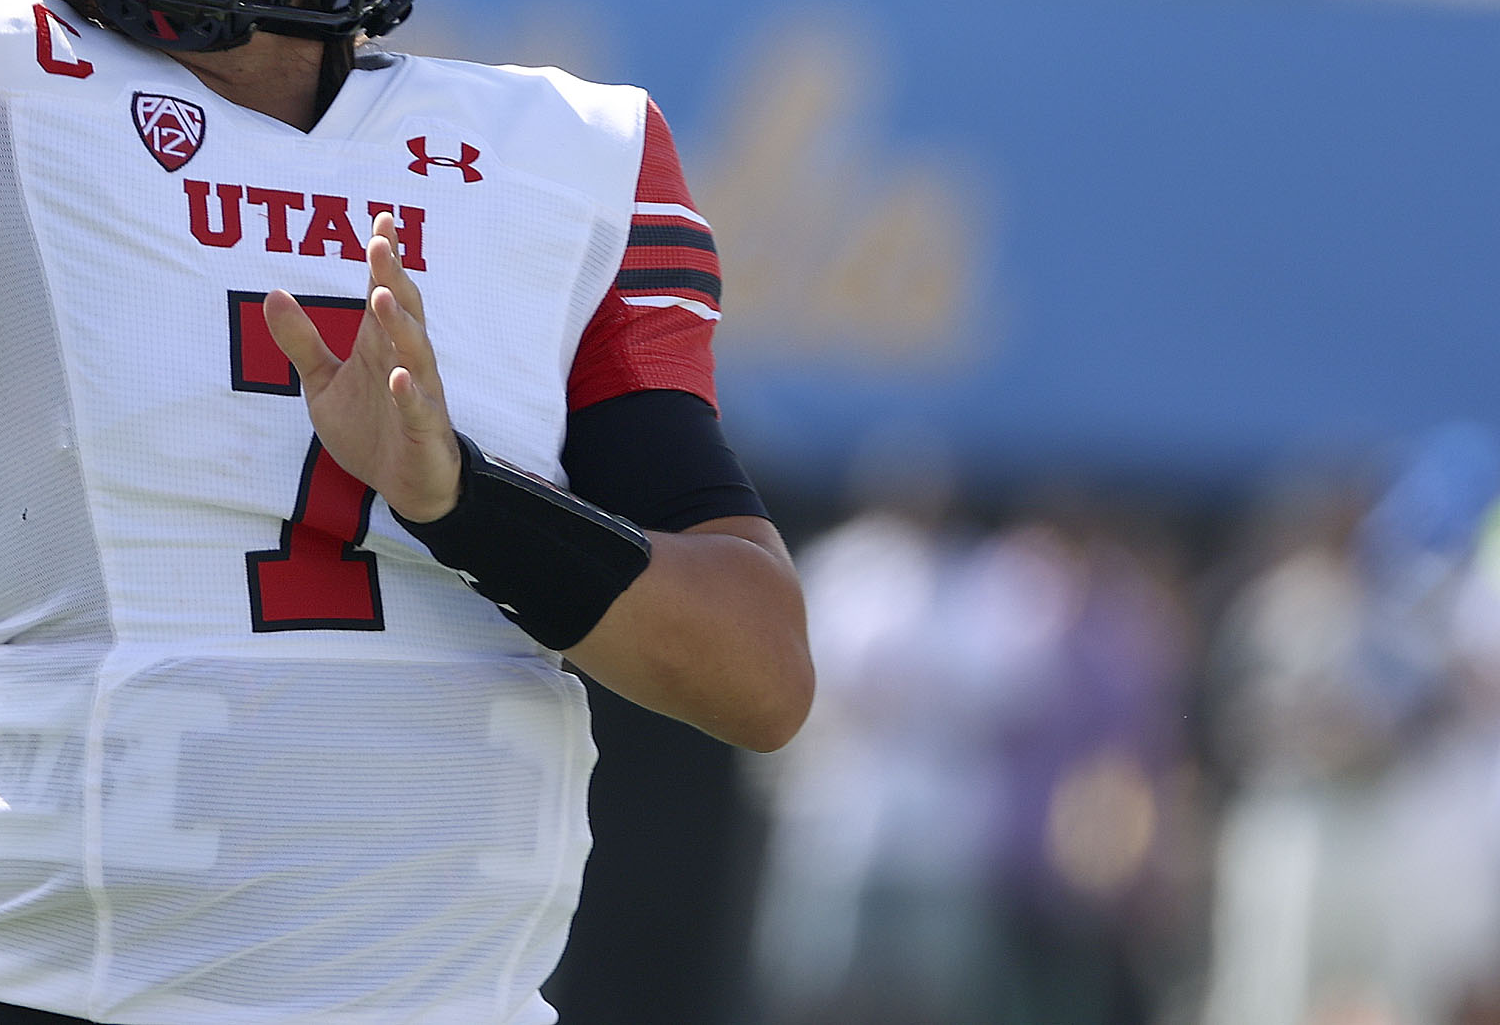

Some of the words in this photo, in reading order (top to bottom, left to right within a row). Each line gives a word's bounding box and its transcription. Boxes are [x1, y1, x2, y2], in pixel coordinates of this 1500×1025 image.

[33, 3, 94, 79] C
[136, 96, 201, 147] PAC
[153, 125, 187, 157] 12
[184, 179, 427, 272] UTAH
[228, 290, 385, 632] 7
